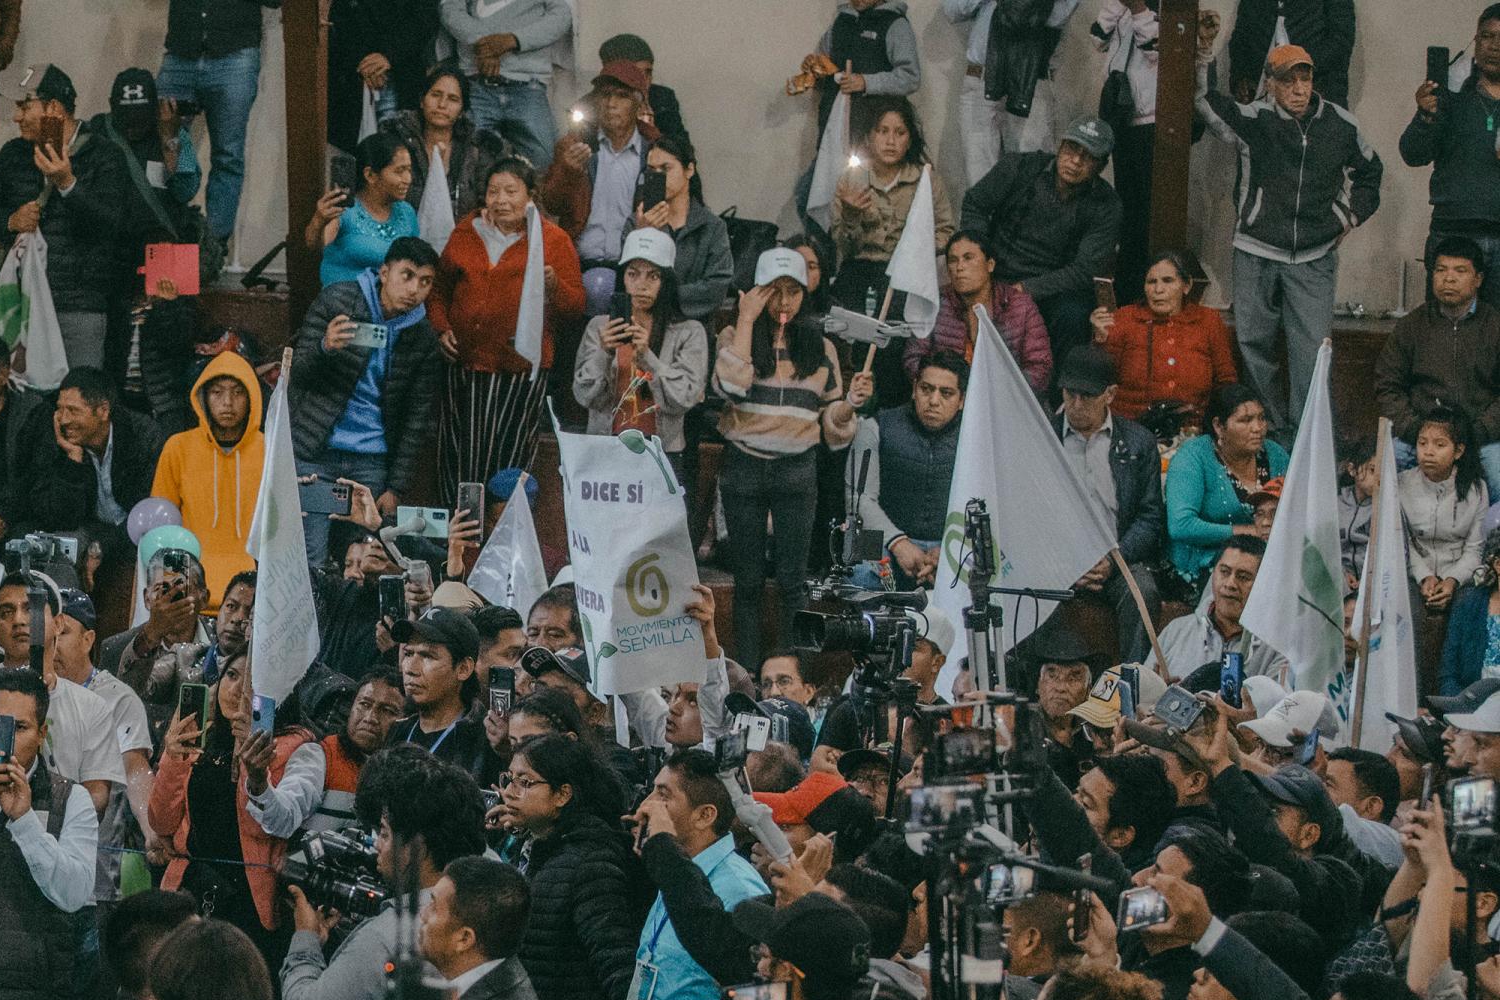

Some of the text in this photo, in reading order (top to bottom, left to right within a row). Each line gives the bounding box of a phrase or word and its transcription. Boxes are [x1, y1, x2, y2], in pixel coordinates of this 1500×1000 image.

[581, 480, 620, 502] DICE
[627, 480, 644, 503] SÍ
[616, 615, 693, 638] MOVIMIENTO
[619, 627, 696, 654] SEMILLA
